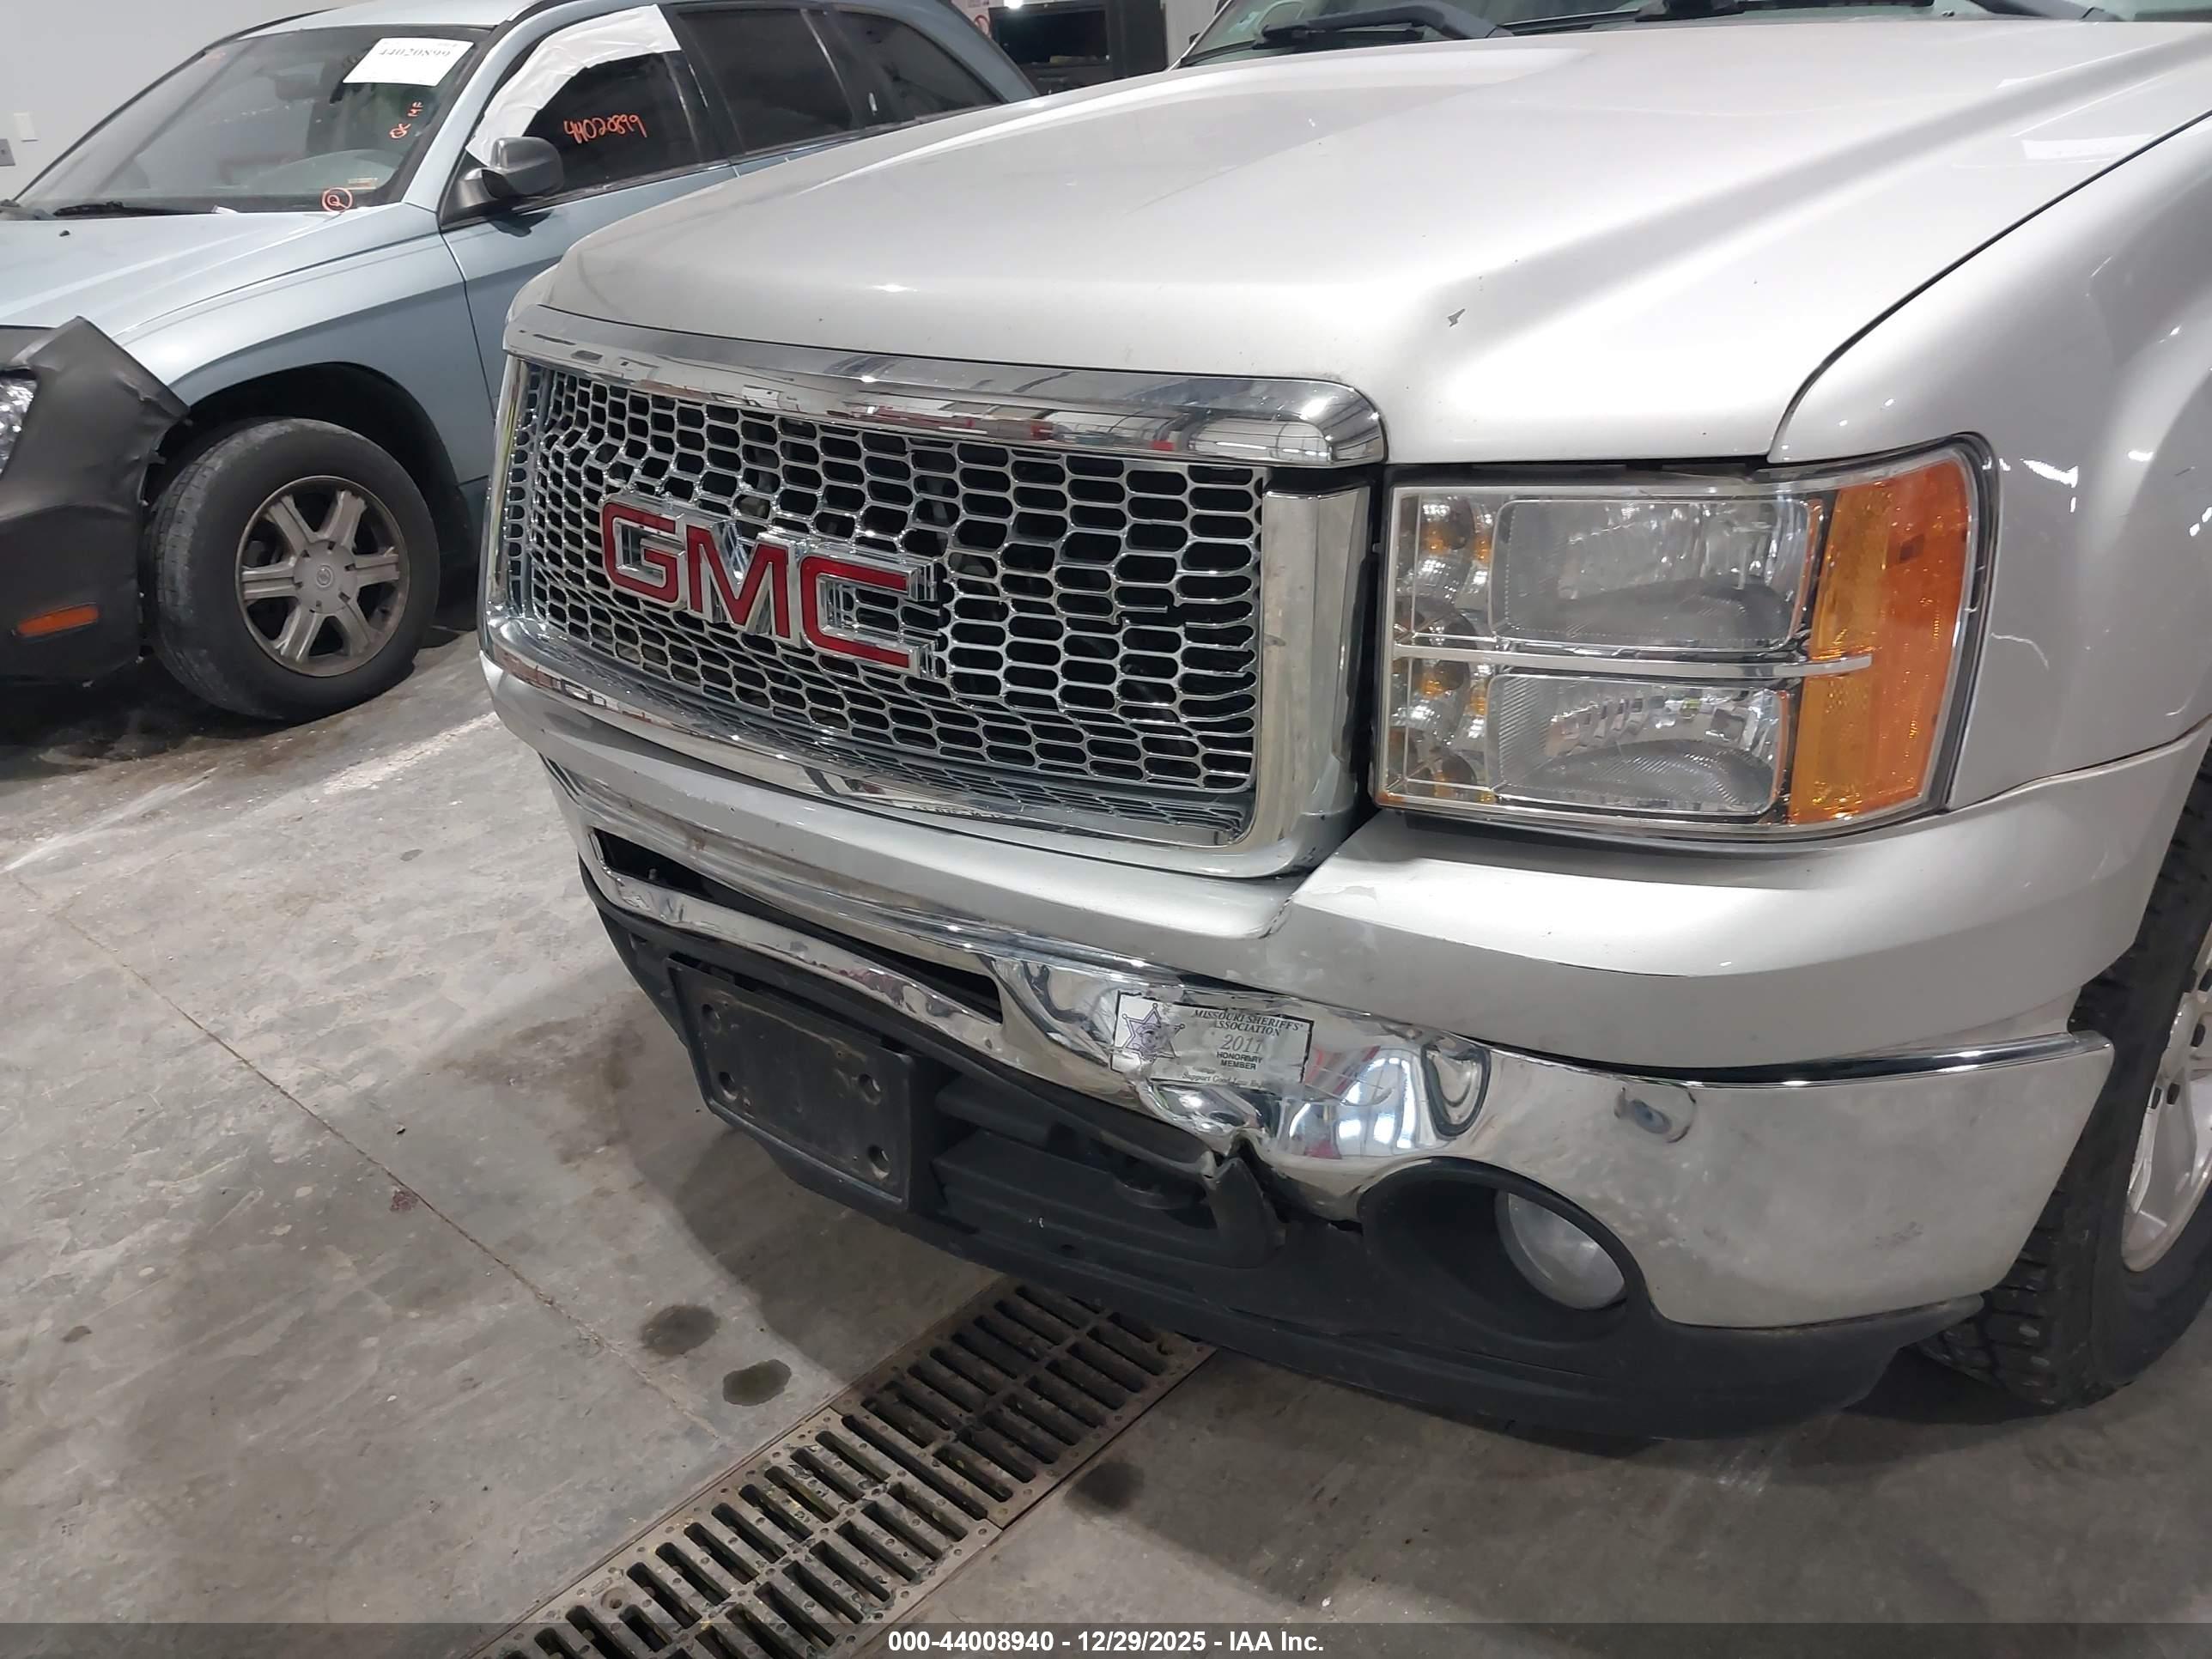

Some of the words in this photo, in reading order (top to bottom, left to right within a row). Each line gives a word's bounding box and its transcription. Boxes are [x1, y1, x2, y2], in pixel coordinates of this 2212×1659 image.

[563, 113, 647, 143] 44020899
[600, 496, 934, 678] GMC
[1191, 1009, 1244, 1023] MISSOURI
[1213, 1019, 1281, 1036] SSOCIATION
[1219, 1033, 1263, 1054] 2011
[1220, 1059, 1257, 1070] MEMBER
